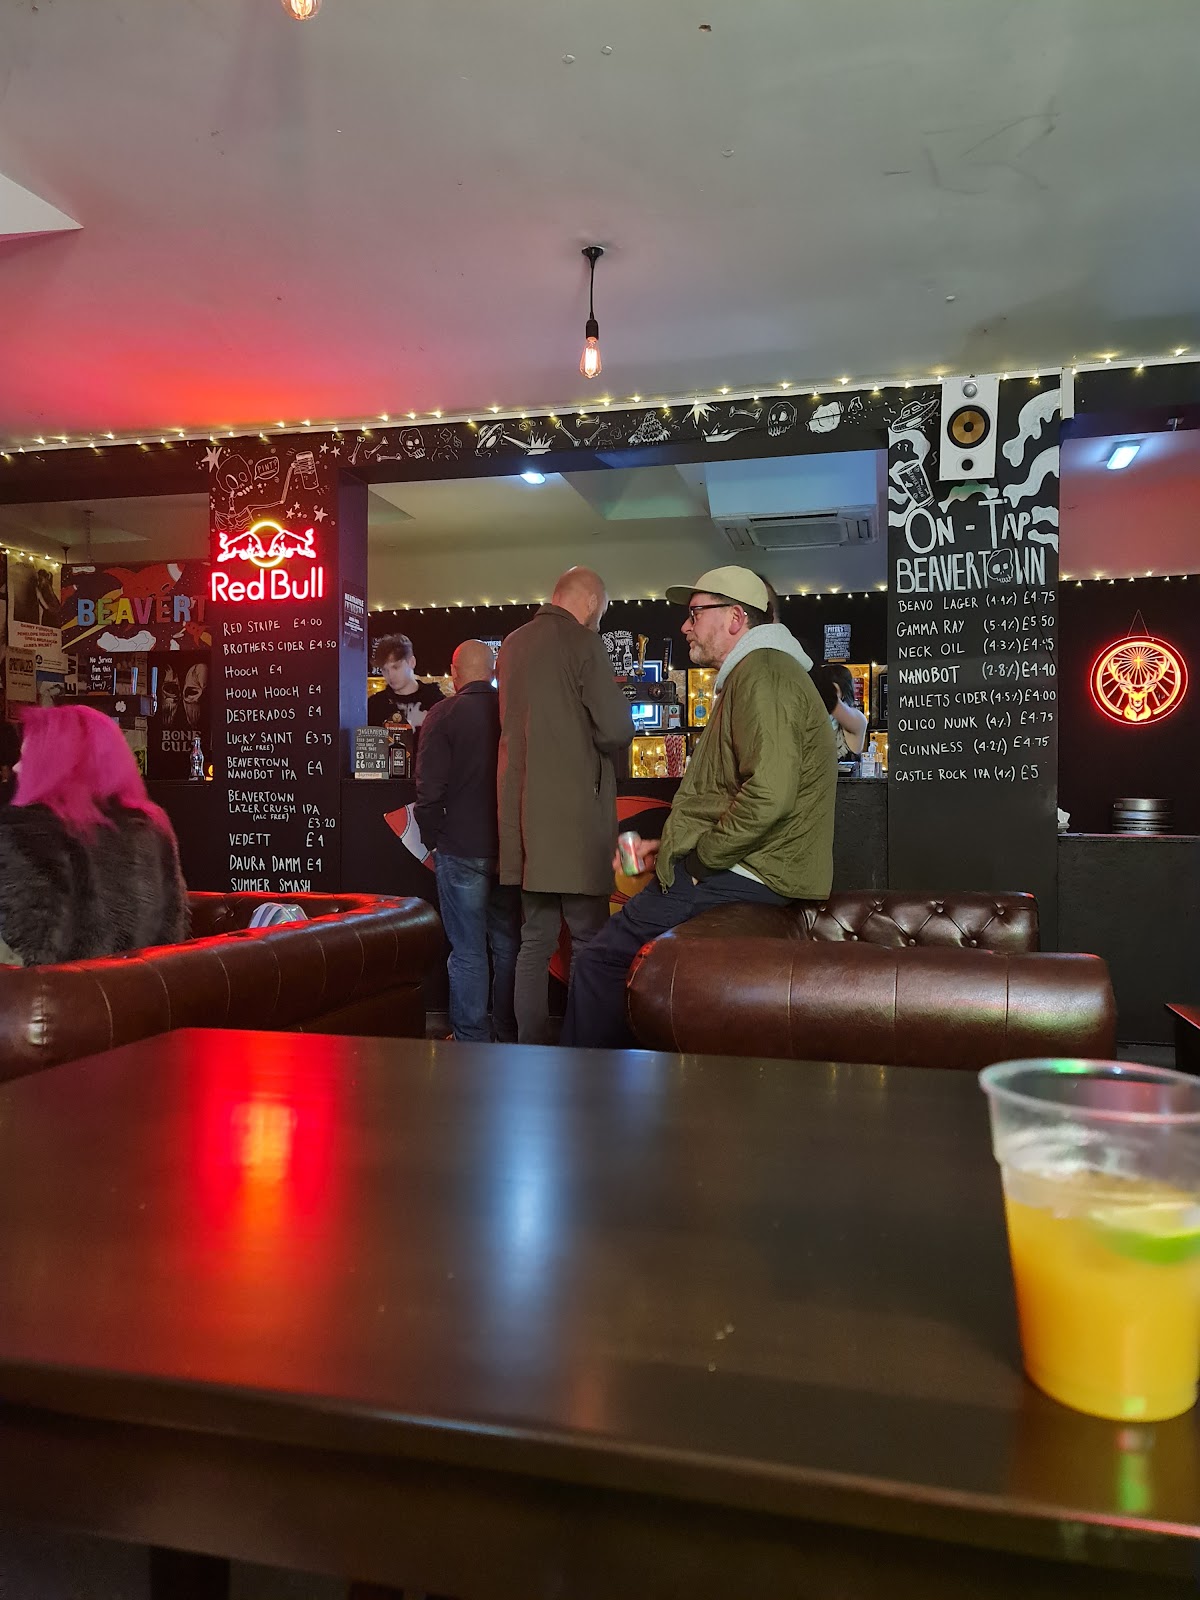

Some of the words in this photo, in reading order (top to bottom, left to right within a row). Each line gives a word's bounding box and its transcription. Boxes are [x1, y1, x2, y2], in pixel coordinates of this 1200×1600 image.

[211, 568, 265, 601] Red
[271, 567, 323, 600] Bull
[898, 600, 934, 613] BEAVO
[943, 596, 979, 610] LAGER
[223, 622, 242, 636] RED
[247, 620, 281, 633] STRIPE
[896, 621, 939, 638] GAMMA
[943, 619, 965, 634] RAY
[223, 641, 274, 656] BROTHERS
[277, 641, 305, 652] CIDER
[898, 645, 933, 660] NECK
[940, 643, 966, 656] OIL
[224, 666, 258, 678] HOOCH
[899, 665, 961, 685] NANOBOT
[225, 687, 258, 700] HOOLA
[264, 686, 300, 699] HOOCH
[899, 693, 950, 709] MALLETS
[955, 691, 988, 705] CIDER
[226, 708, 296, 724] DESPERADOS
[944, 716, 978, 730] NUNK
[162, 730, 202, 741] BONE
[226, 731, 256, 745] LUCKY
[260, 731, 293, 744] SAINT
[161, 741, 195, 752] CUL
[899, 741, 963, 756] GUINNESS
[227, 756, 289, 769] BEAVERTOWN
[227, 769, 274, 780] NANOBOT
[281, 769, 297, 780] IPA
[895, 769, 934, 782] CASTLE
[938, 768, 968, 781] ROCK
[974, 768, 991, 779] IPA
[1021, 764, 1039, 780] £5
[228, 789, 294, 803] BEAVERTOWN
[228, 803, 261, 813] LAZER
[263, 804, 297, 813] CRUSH
[302, 803, 320, 815] IPA
[229, 832, 271, 847] VEDETT
[229, 854, 266, 871] DAURA
[272, 855, 302, 873] DAMM
[230, 877, 270, 892] SUMMER
[279, 878, 311, 892] SMASH
